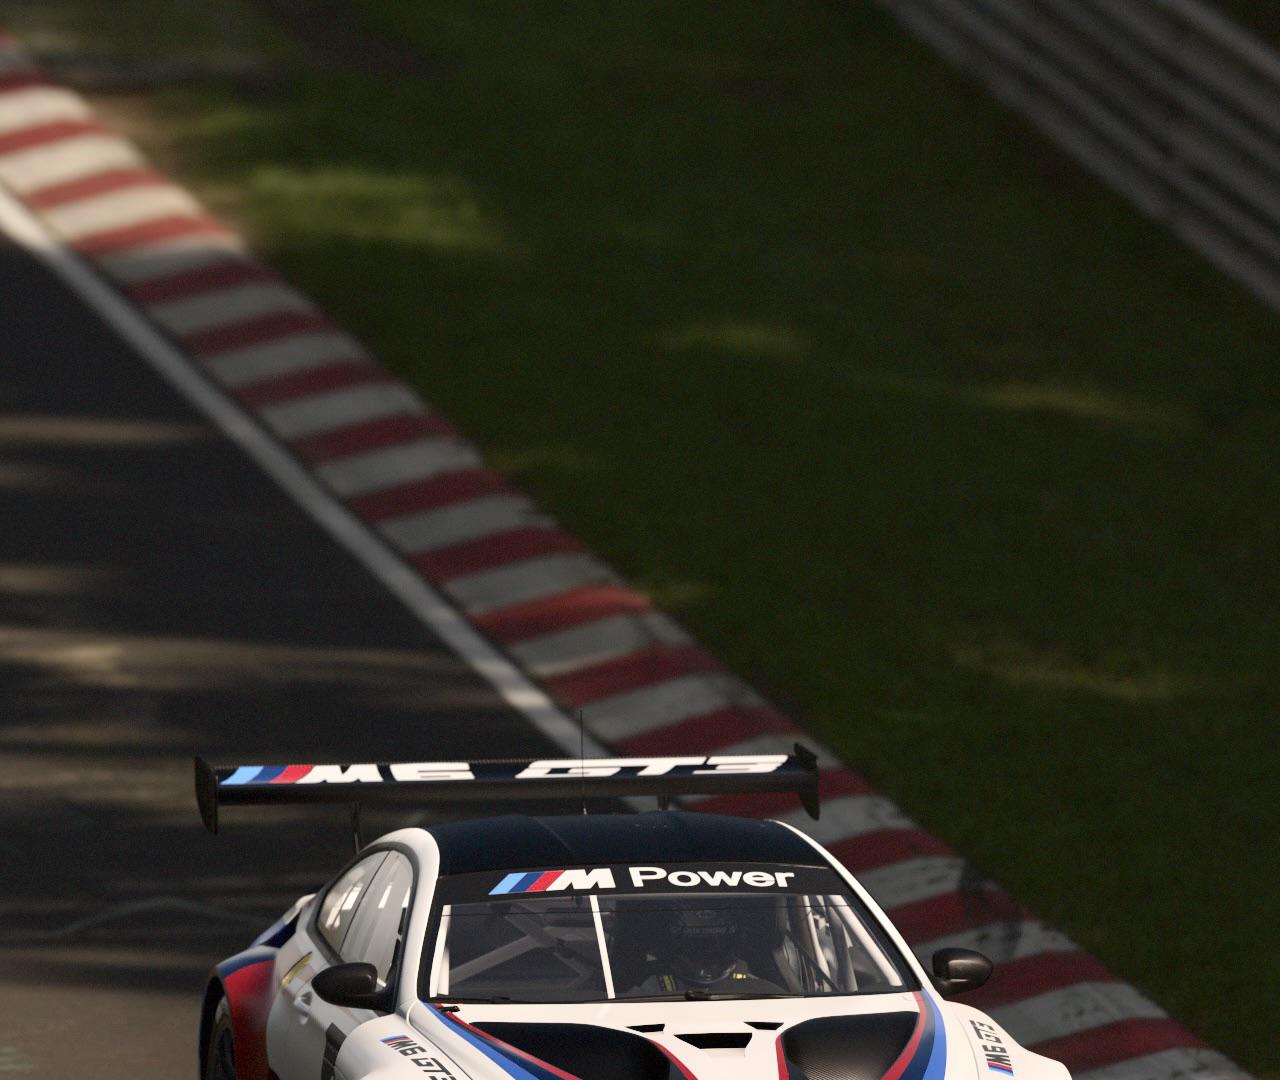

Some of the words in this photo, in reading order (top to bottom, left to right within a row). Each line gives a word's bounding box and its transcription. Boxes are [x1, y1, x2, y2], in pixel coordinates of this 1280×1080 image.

[295, 761, 475, 784] M6
[515, 755, 789, 779] GT3
[546, 867, 616, 891] M
[629, 866, 795, 888] Power
[969, 1019, 1003, 1044] GT3
[387, 1039, 428, 1057] M6
[982, 1044, 1012, 1066] M6
